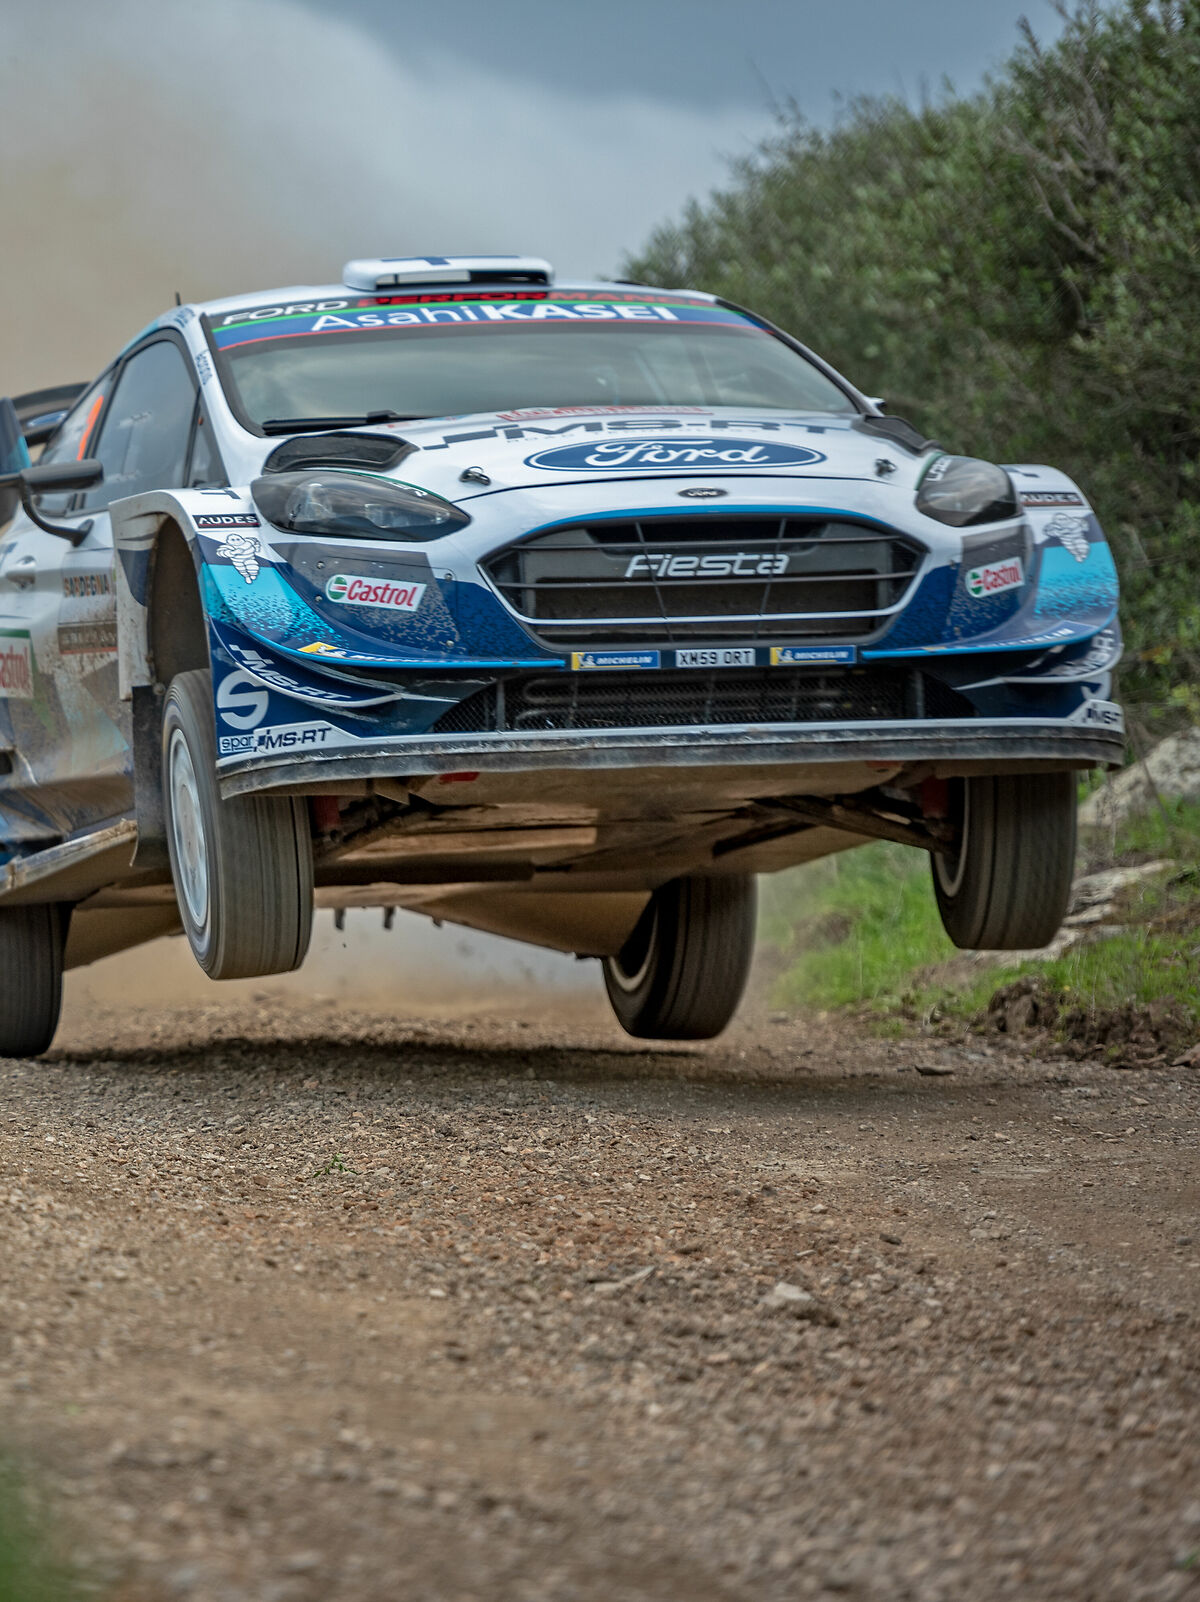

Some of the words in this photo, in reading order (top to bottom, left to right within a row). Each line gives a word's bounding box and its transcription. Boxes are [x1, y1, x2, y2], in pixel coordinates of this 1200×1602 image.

[223, 300, 349, 326] FORD
[502, 419, 850, 440] MS-RT
[585, 440, 770, 467] Ford
[198, 515, 258, 525] AUDES
[624, 552, 790, 578] Fiesta
[983, 560, 1022, 591] Castrol
[346, 579, 419, 607] Castrol
[596, 655, 653, 665] MICHELIN
[793, 650, 849, 660] MICHELIN
[238, 656, 352, 699] MS-RT
[263, 727, 332, 750] MS-RT
